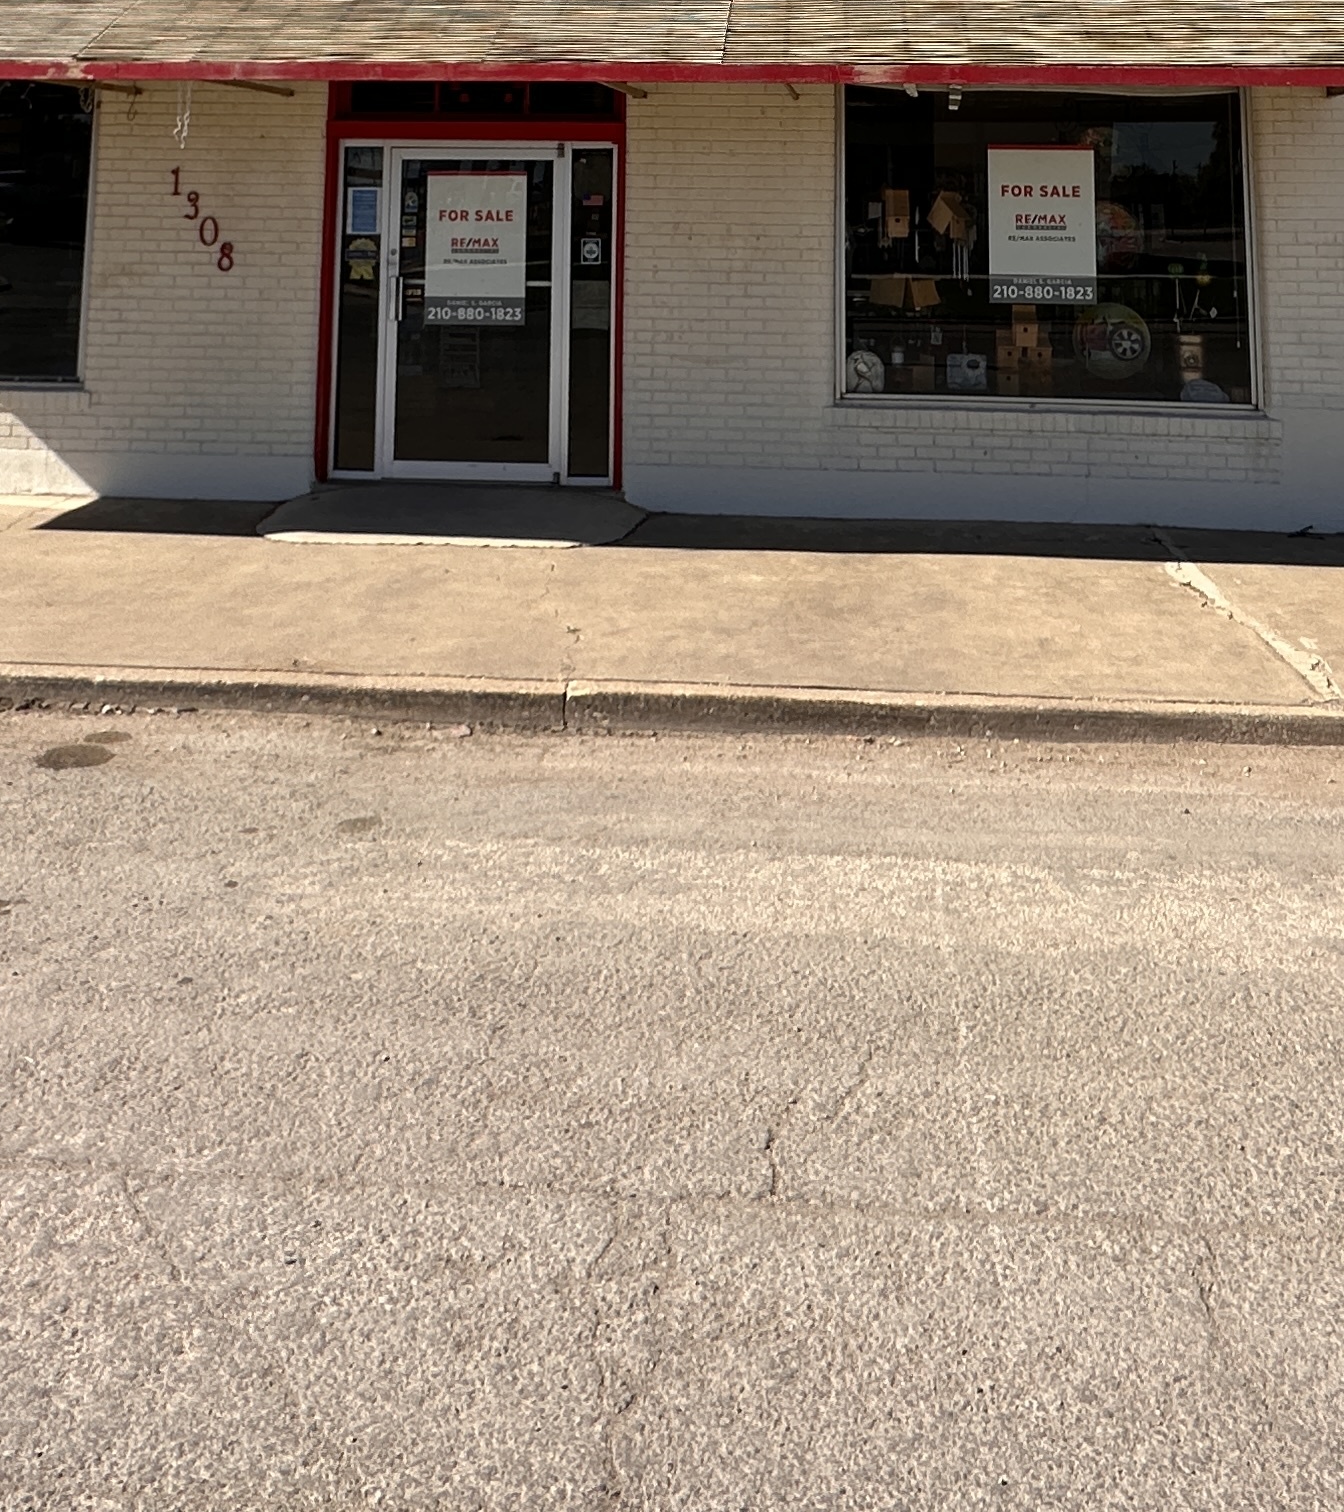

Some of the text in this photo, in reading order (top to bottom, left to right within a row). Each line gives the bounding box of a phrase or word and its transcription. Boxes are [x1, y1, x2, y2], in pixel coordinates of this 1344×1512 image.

[1001, 185, 1081, 198] FOR SALE
[170, 166, 235, 272] 1308
[439, 209, 514, 222] FOR SALE
[1015, 214, 1066, 225] RE/MAX
[451, 237, 499, 248] RE/MAX
[993, 285, 1093, 300] 210-880-1823
[427, 307, 522, 320] 210-880-1823
